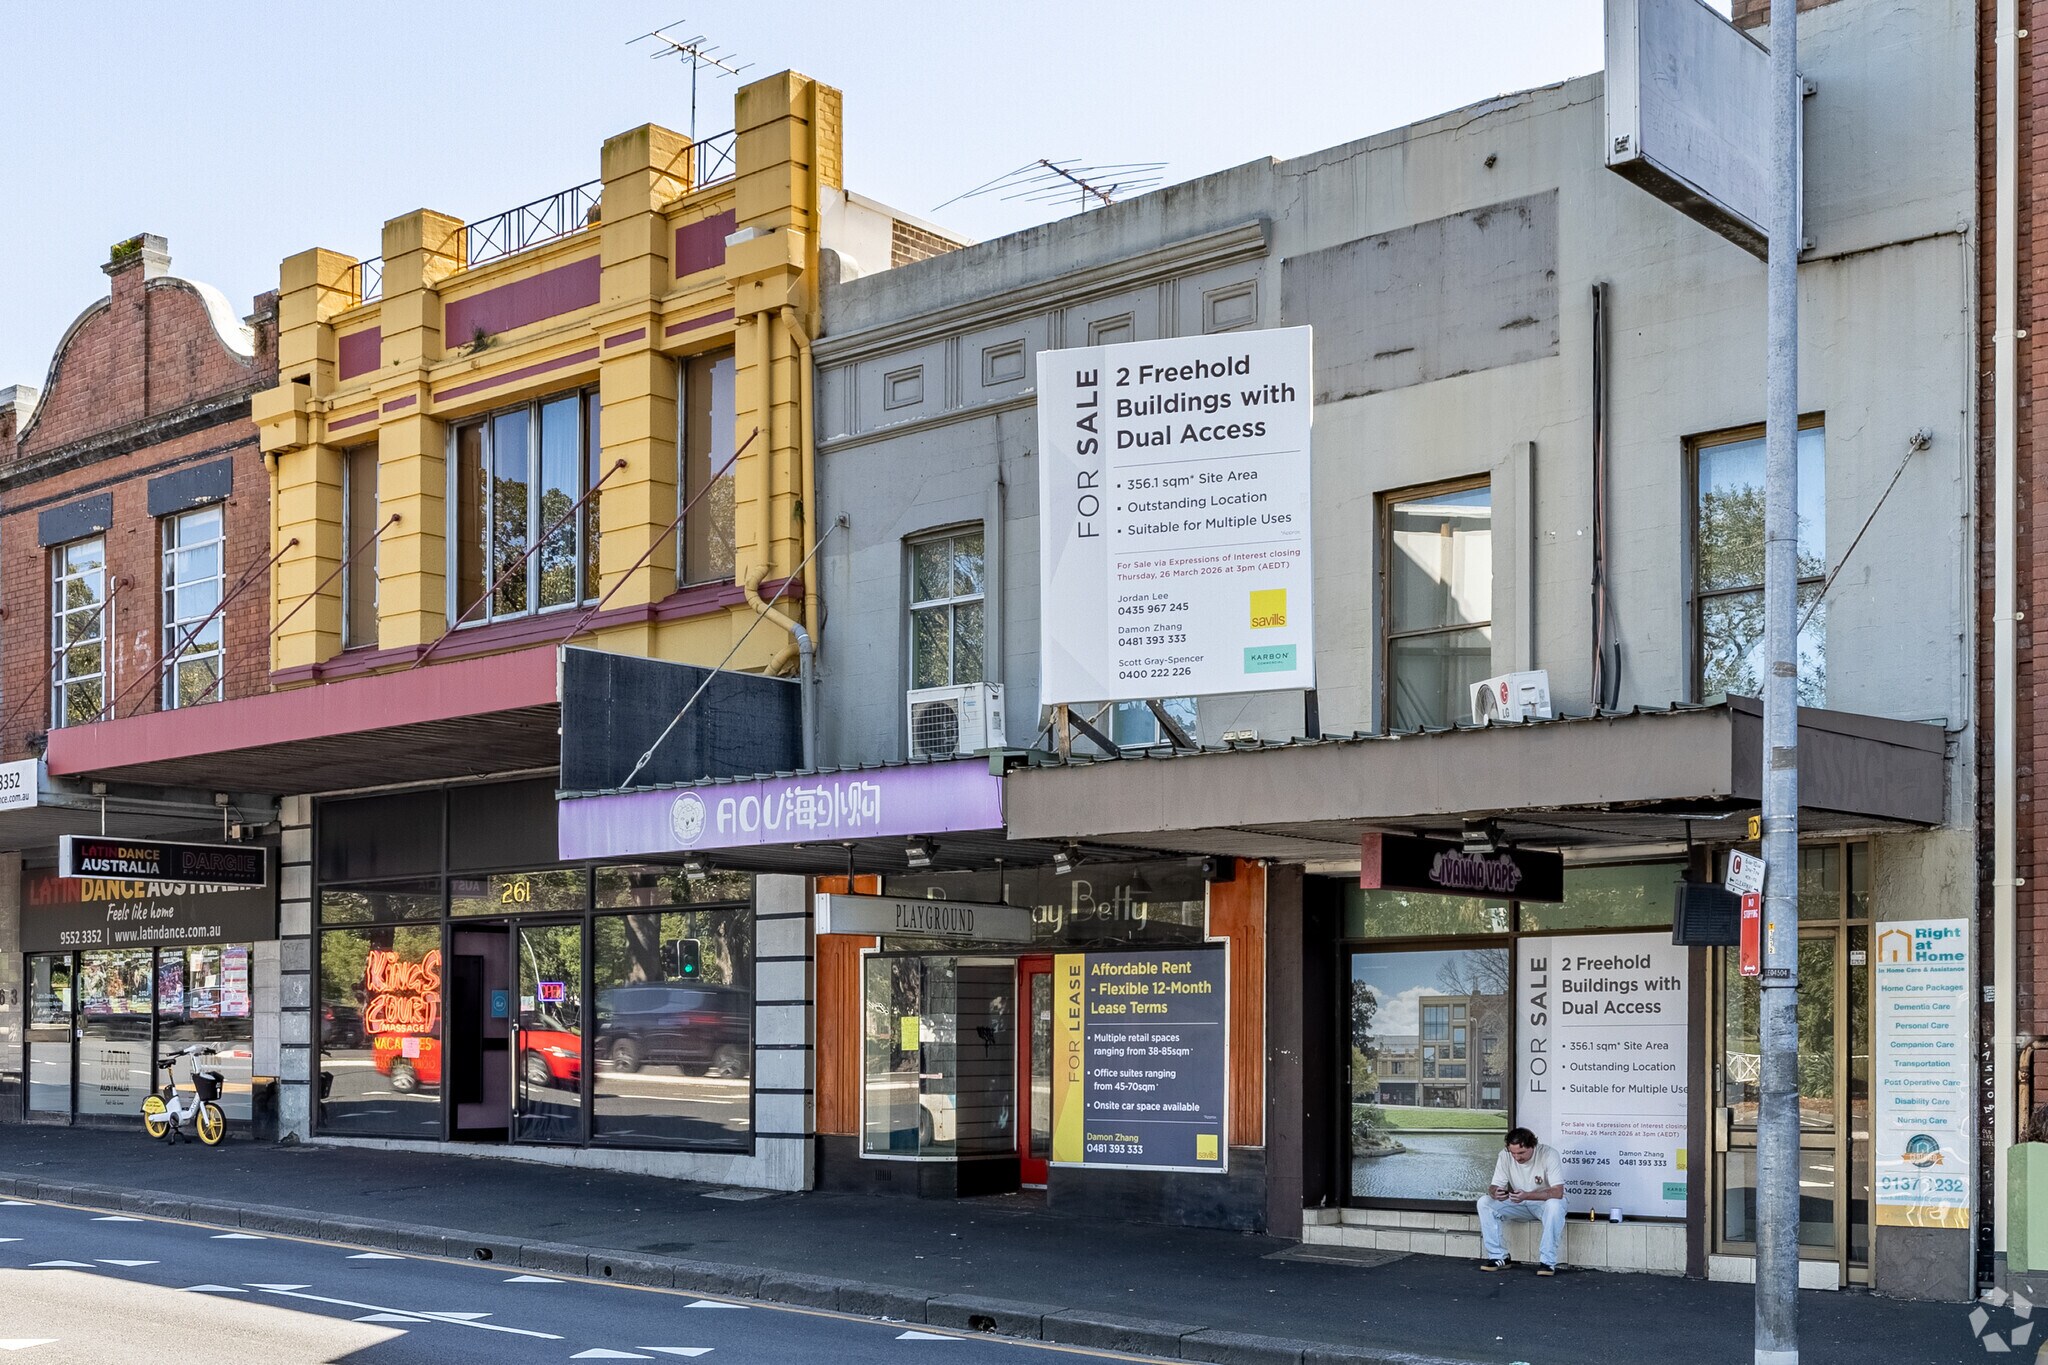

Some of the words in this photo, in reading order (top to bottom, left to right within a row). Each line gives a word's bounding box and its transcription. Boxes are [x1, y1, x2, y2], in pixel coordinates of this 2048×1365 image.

[1116, 367, 1130, 387] 2
[1139, 354, 1250, 385] Freehold
[1116, 390, 1232, 418] Buildings
[1241, 382, 1296, 407] with
[1076, 368, 1099, 455] SALE
[1116, 425, 1171, 449] Dual
[1180, 420, 1267, 444] Access
[1127, 477, 1159, 490] 356.1
[1198, 471, 1225, 484] Site
[1227, 469, 1258, 482] Area
[1077, 470, 1100, 538] FOR
[1127, 496, 1207, 513] Outstanding
[1210, 491, 1268, 506] Location
[1127, 519, 1180, 536] Suitable
[1183, 518, 1202, 532] for
[1205, 514, 1258, 532] Multiple
[1261, 512, 1292, 525] Uses
[1117, 562, 1131, 570] For
[1133, 560, 1152, 569] Sale
[1153, 558, 1167, 568] via
[1169, 554, 1219, 568] Expressions
[1222, 553, 1232, 563] of
[1233, 550, 1267, 561] Interest
[1269, 548, 1301, 560] closing
[1117, 571, 1158, 582] Thursday,
[1160, 569, 1171, 578] 26
[1173, 567, 1199, 577] March
[1201, 565, 1223, 575] 2026
[1225, 564, 1234, 573] at
[1236, 563, 1255, 574] 3pm
[1257, 560, 1291, 572] (AEDT)
[1117, 592, 1150, 604] Jordan
[1152, 591, 1169, 602] Lee
[1117, 605, 1145, 616] 0435
[1147, 603, 1167, 614] 967
[1169, 601, 1189, 612] 245
[1251, 613, 1287, 628] savills
[1117, 624, 1150, 635] Damon
[1153, 622, 1183, 634] Zhang
[1118, 636, 1143, 647] 0481
[1146, 635, 1165, 646] 393
[1167, 633, 1187, 645] 333
[1118, 657, 1142, 668] Scott
[1144, 654, 1205, 668] Gray-Spencer
[1118, 669, 1148, 680] 0400
[1150, 668, 1170, 679] 222
[1171, 666, 1192, 678] 226
[1502, 707, 1510, 719] LG
[81, 858, 161, 875] AUSTRALIA
[182, 851, 256, 873] DARGIE
[1486, 860, 1516, 892] VAPE
[501, 881, 531, 904] 261
[107, 902, 130, 922] Feels
[131, 902, 148, 920] like
[150, 901, 175, 919] home
[1071, 879, 1148, 931] Betty
[895, 903, 974, 932] PLAYGROUND
[60, 931, 81, 945] 9552
[82, 930, 102, 944] 3352
[114, 924, 221, 943] www.latindance.com.au
[1915, 927, 1961, 940] Right
[1915, 940, 1933, 950] at
[1562, 957, 1571, 971] 2
[1577, 954, 1651, 970] Freehold
[1915, 952, 1965, 962] Home
[1091, 961, 1158, 976] Affordable
[1161, 961, 1192, 974] Rent
[1099, 981, 1149, 996] Flexible
[1152, 980, 1212, 995] 12-Month
[1530, 957, 1547, 1026] SALE
[1562, 978, 1639, 994] Buildings
[1644, 976, 1681, 991] with
[1881, 984, 1904, 992] Home
[1905, 984, 1924, 992] Care
[1925, 984, 1964, 993] Packages
[1069, 965, 1081, 1031] LEASE
[1091, 1002, 1127, 1014] Lease
[1130, 1001, 1168, 1014] Terms
[1562, 1000, 1599, 1015] Dual
[1604, 1000, 1662, 1014] Access
[1893, 1003, 1931, 1011] Dementia
[381, 1023, 426, 1033] MASSAGE
[374, 1037, 432, 1051] VACAES
[1094, 1033, 1127, 1043] Multiple
[1128, 1033, 1150, 1042] retail
[1151, 1034, 1180, 1044] spaces
[1570, 1041, 1594, 1050] 356.1
[1623, 1041, 1643, 1050] Site
[1645, 1041, 1669, 1050] Area
[1890, 1041, 1935, 1050] Companion
[1094, 1047, 1125, 1057] ranging
[1126, 1046, 1146, 1056] from
[1069, 1040, 1081, 1082] FOR
[1530, 1038, 1547, 1094] FOR
[1570, 1061, 1630, 1072] Outstanding
[1632, 1062, 1676, 1072] Location
[1894, 1060, 1951, 1068] Transportation
[101, 1069, 130, 1081] DANCE
[1094, 1068, 1118, 1078] Office
[1119, 1069, 1143, 1078] suites
[1145, 1070, 1177, 1079] ranging
[100, 1083, 130, 1092] AUSTRALIA
[1094, 1082, 1113, 1091] from
[1570, 1083, 1609, 1093] Suitable
[1611, 1083, 1626, 1093] for
[1628, 1084, 1668, 1095] Multiple
[1903, 1079, 1940, 1087] Operative
[1094, 1100, 1120, 1110] Onsite
[1121, 1103, 1135, 1111] car
[1136, 1103, 1161, 1112] space
[1162, 1102, 1200, 1112] available
[1894, 1097, 1929, 1106] Disability
[1897, 1116, 1928, 1125] Nursing
[1087, 1132, 1114, 1142] Damon
[1115, 1133, 1139, 1143] Zhang
[1087, 1143, 1108, 1153] 0481
[1109, 1144, 1126, 1154] 393
[1127, 1144, 1144, 1155] 333
[1198, 1150, 1217, 1159] savills
[1562, 1157, 1580, 1165] 0435
[1581, 1157, 1596, 1165] 967
[1597, 1158, 1611, 1166] 245
